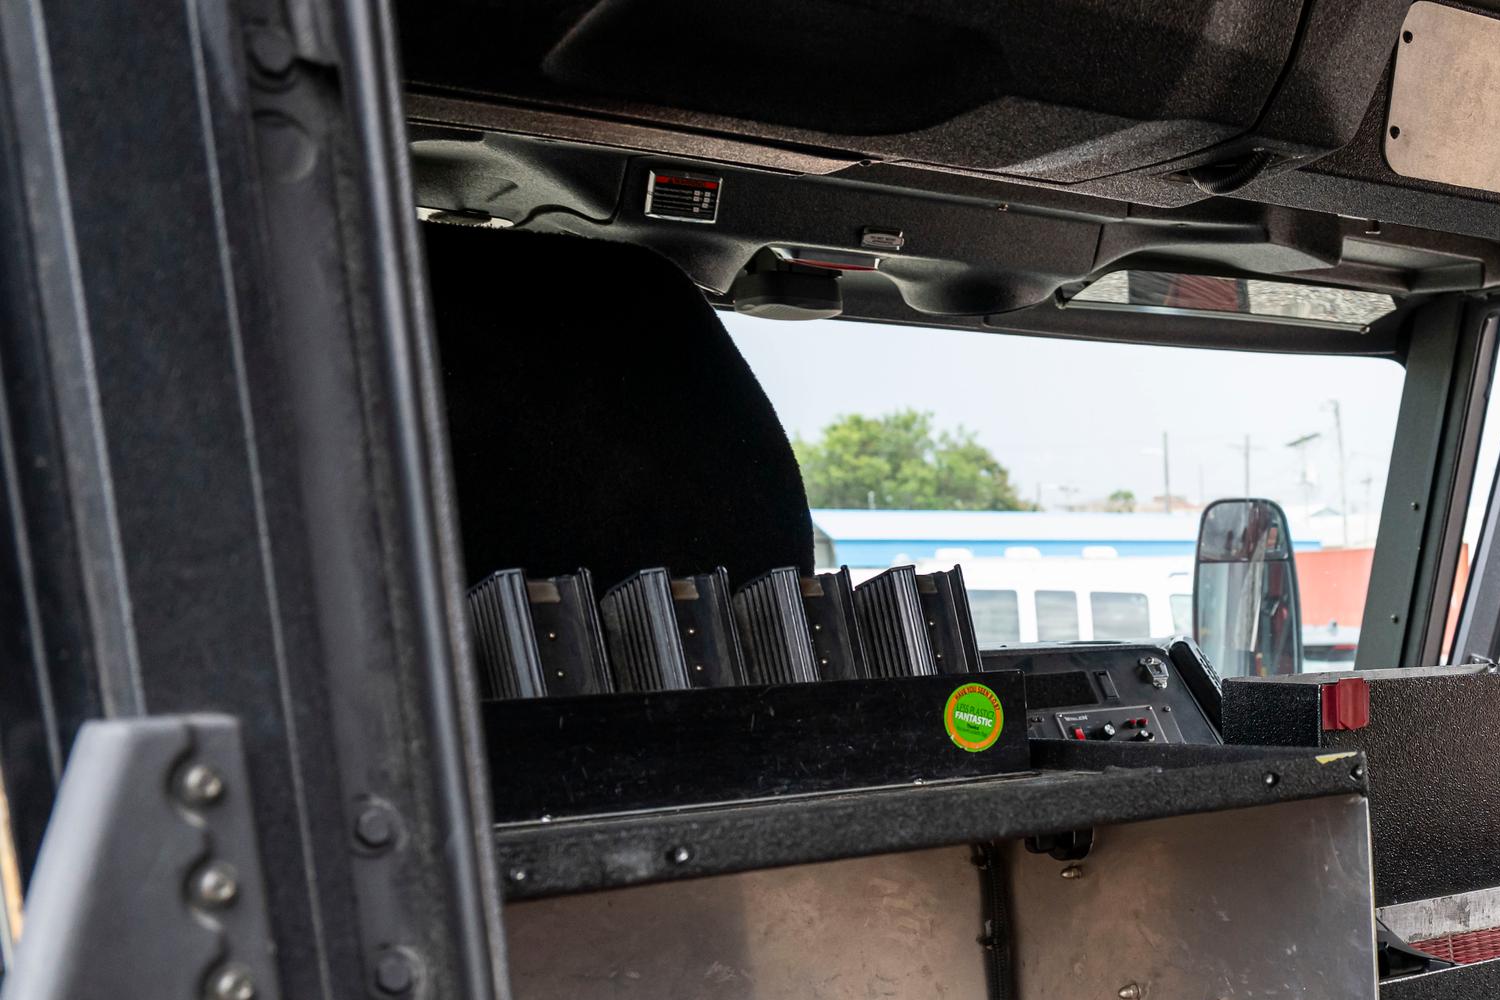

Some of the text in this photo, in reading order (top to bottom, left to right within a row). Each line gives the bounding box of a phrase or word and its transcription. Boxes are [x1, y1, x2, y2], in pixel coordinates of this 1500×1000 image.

[977, 686, 990, 697] SEEN
[956, 703, 969, 713] LESS
[955, 711, 993, 727] FANTASTIC
